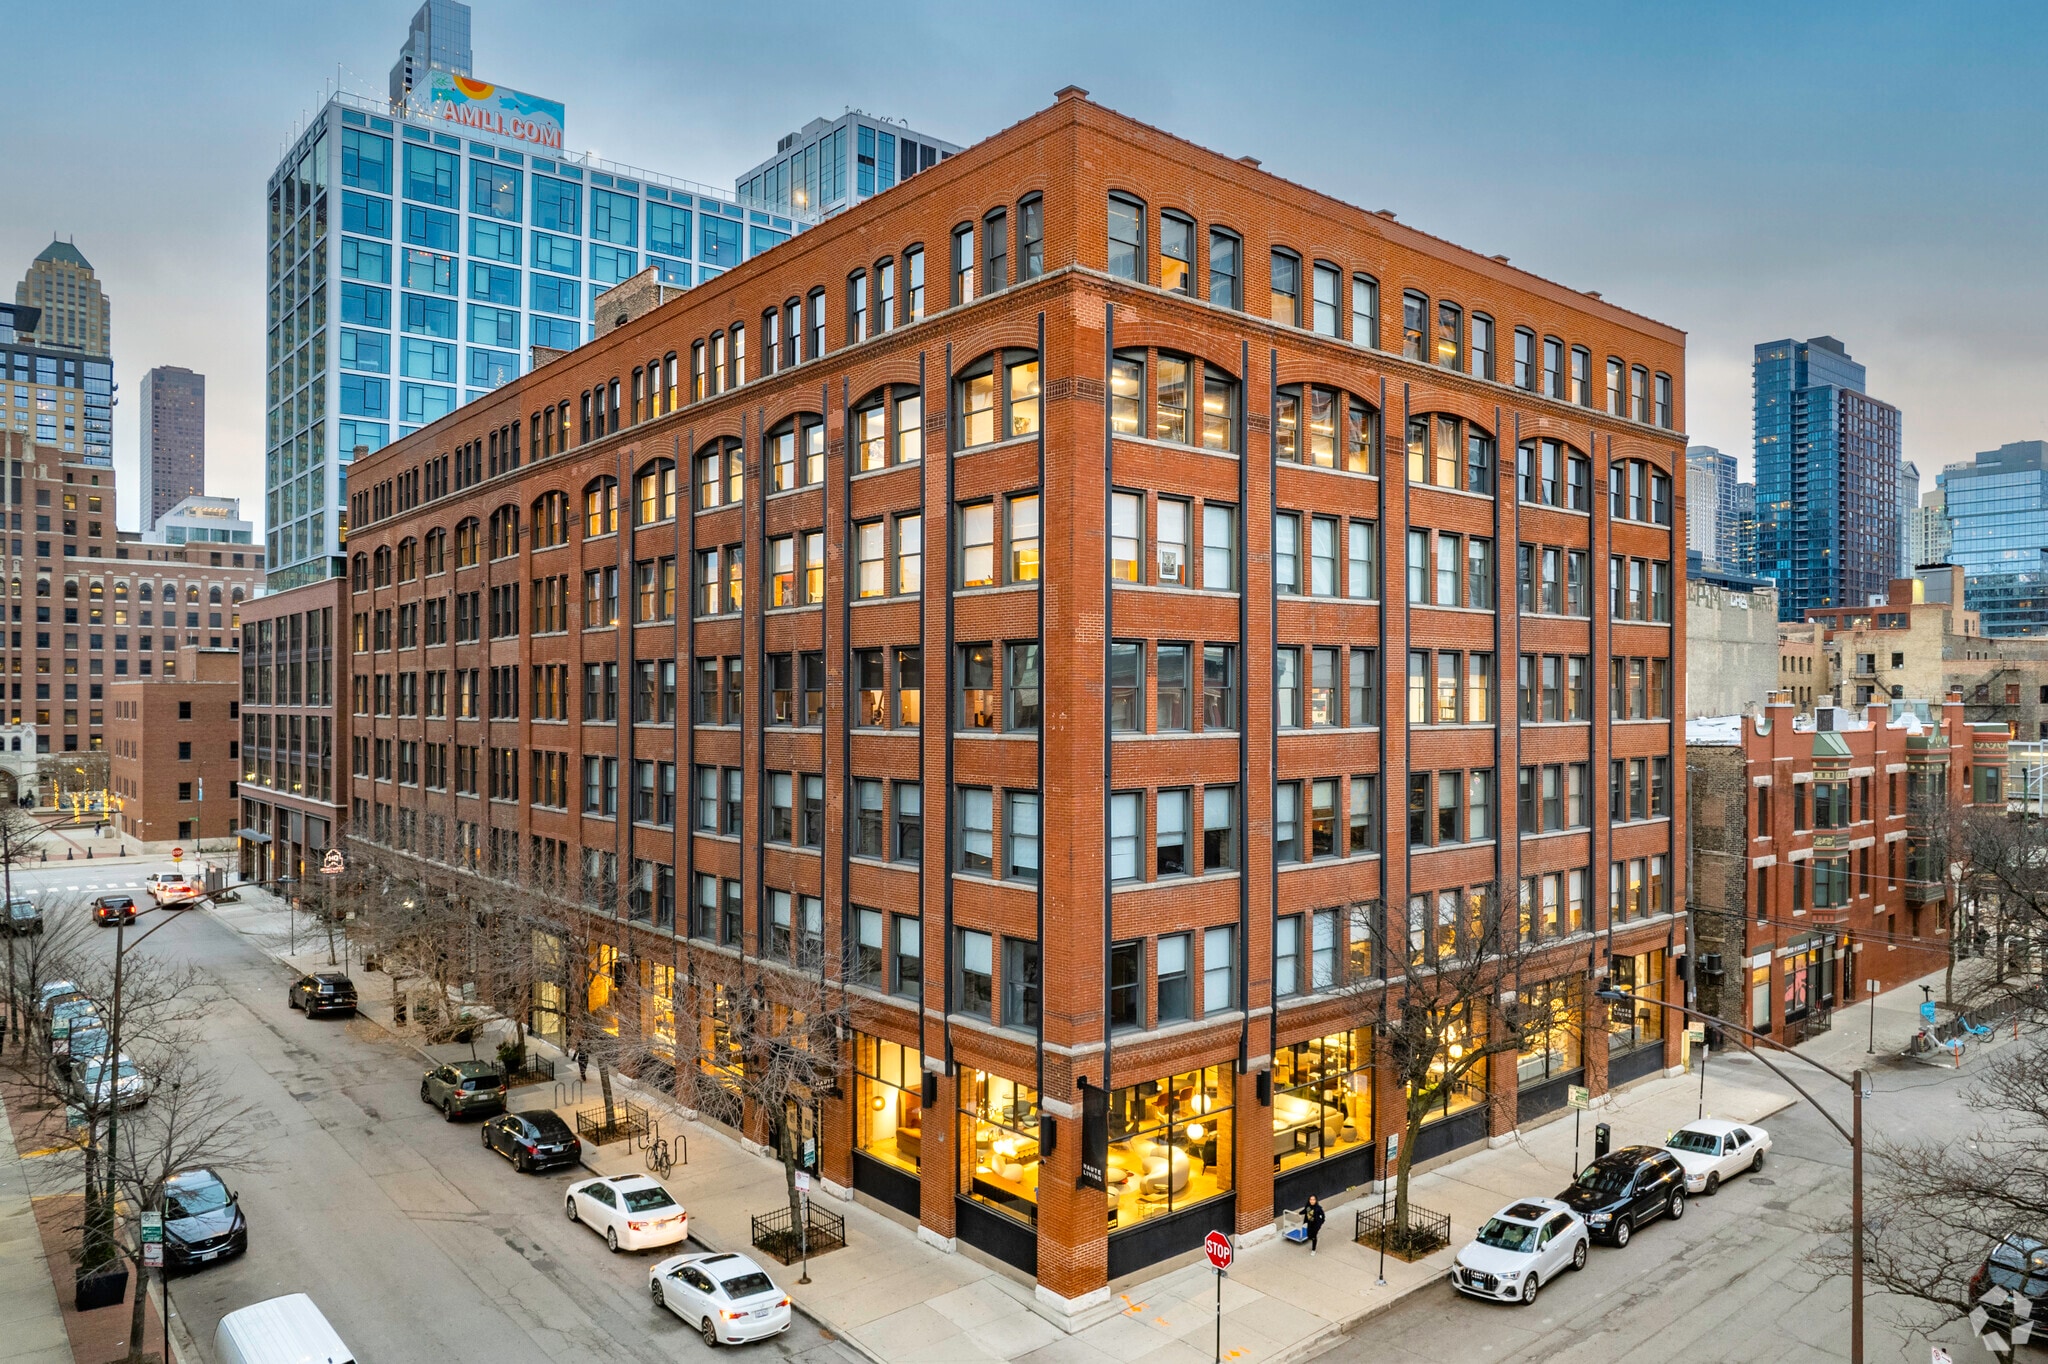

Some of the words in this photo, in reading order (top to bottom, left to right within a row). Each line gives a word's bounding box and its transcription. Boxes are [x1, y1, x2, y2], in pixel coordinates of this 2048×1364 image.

[443, 100, 561, 149] AMLI.COM
[1083, 1163, 1102, 1176] HAUTE
[1083, 1169, 1102, 1183] LIVING
[1206, 1240, 1230, 1260] STOP
